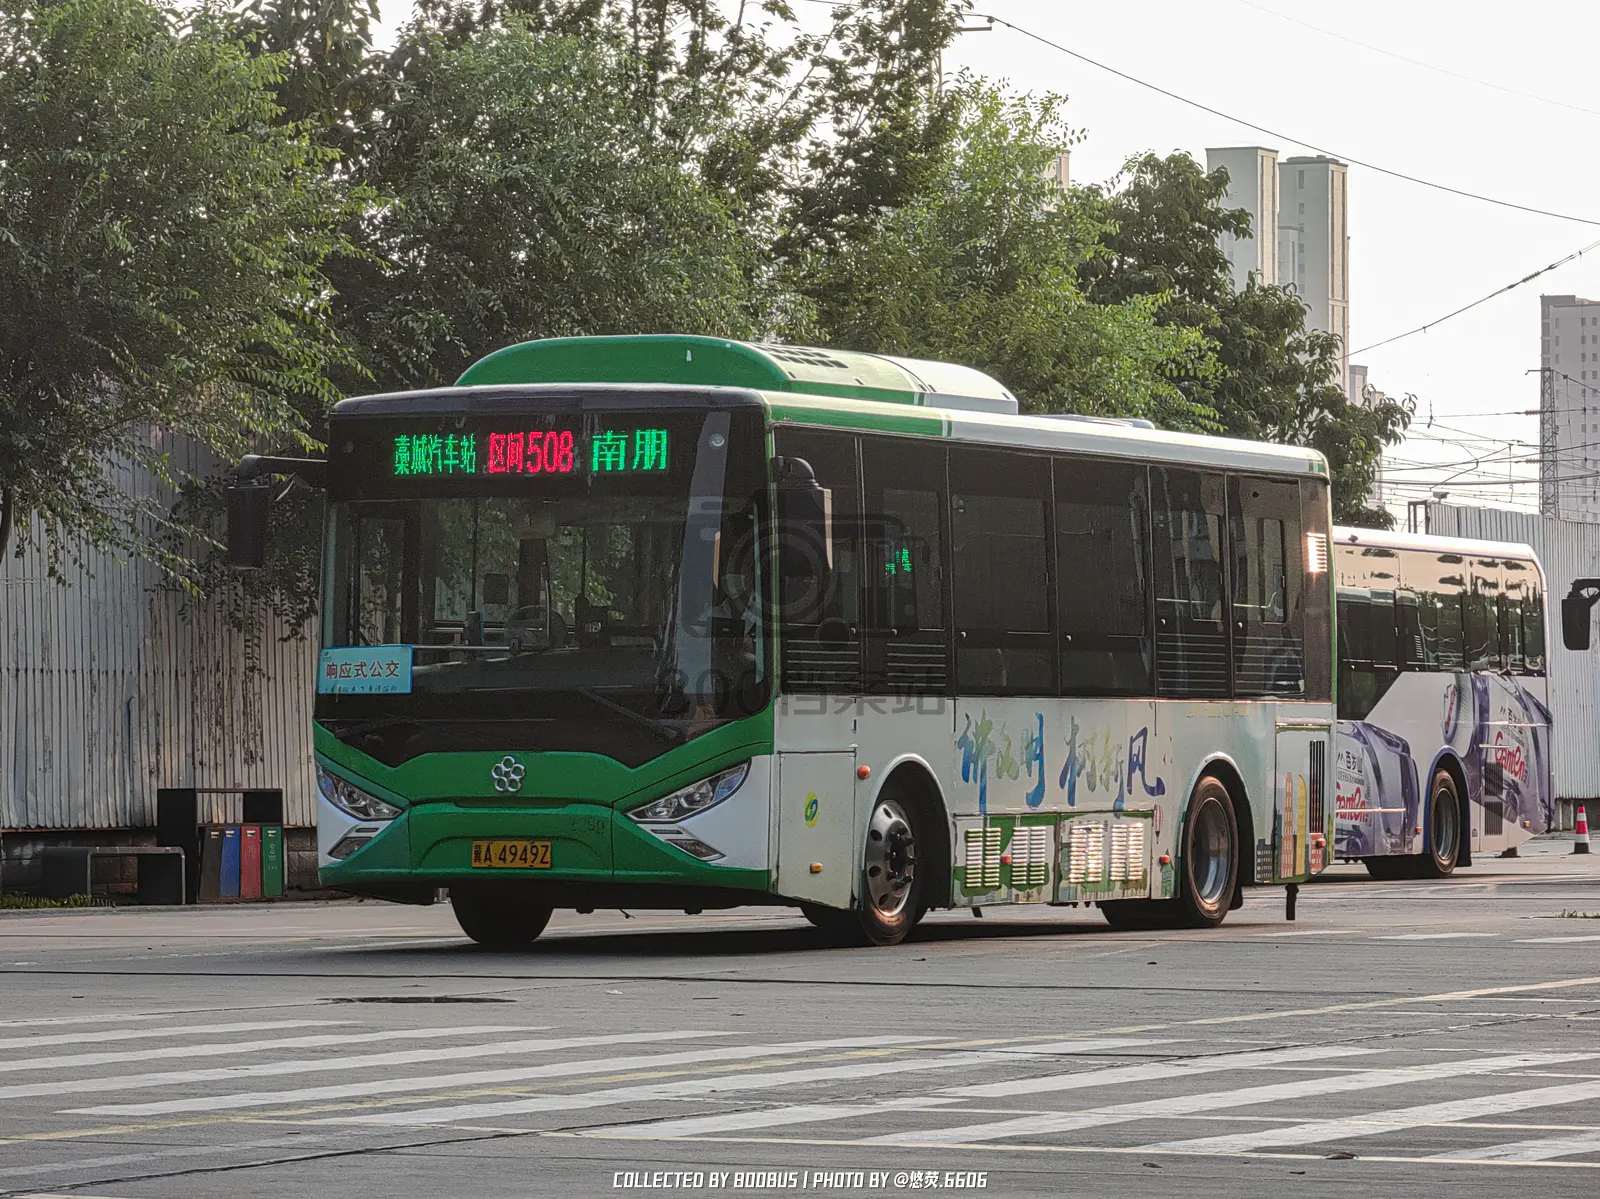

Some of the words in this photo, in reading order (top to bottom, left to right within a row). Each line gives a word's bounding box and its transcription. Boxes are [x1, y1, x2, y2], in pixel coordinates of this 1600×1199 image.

[592, 429, 668, 472] 南朋
[326, 660, 400, 679] 响应式公交
